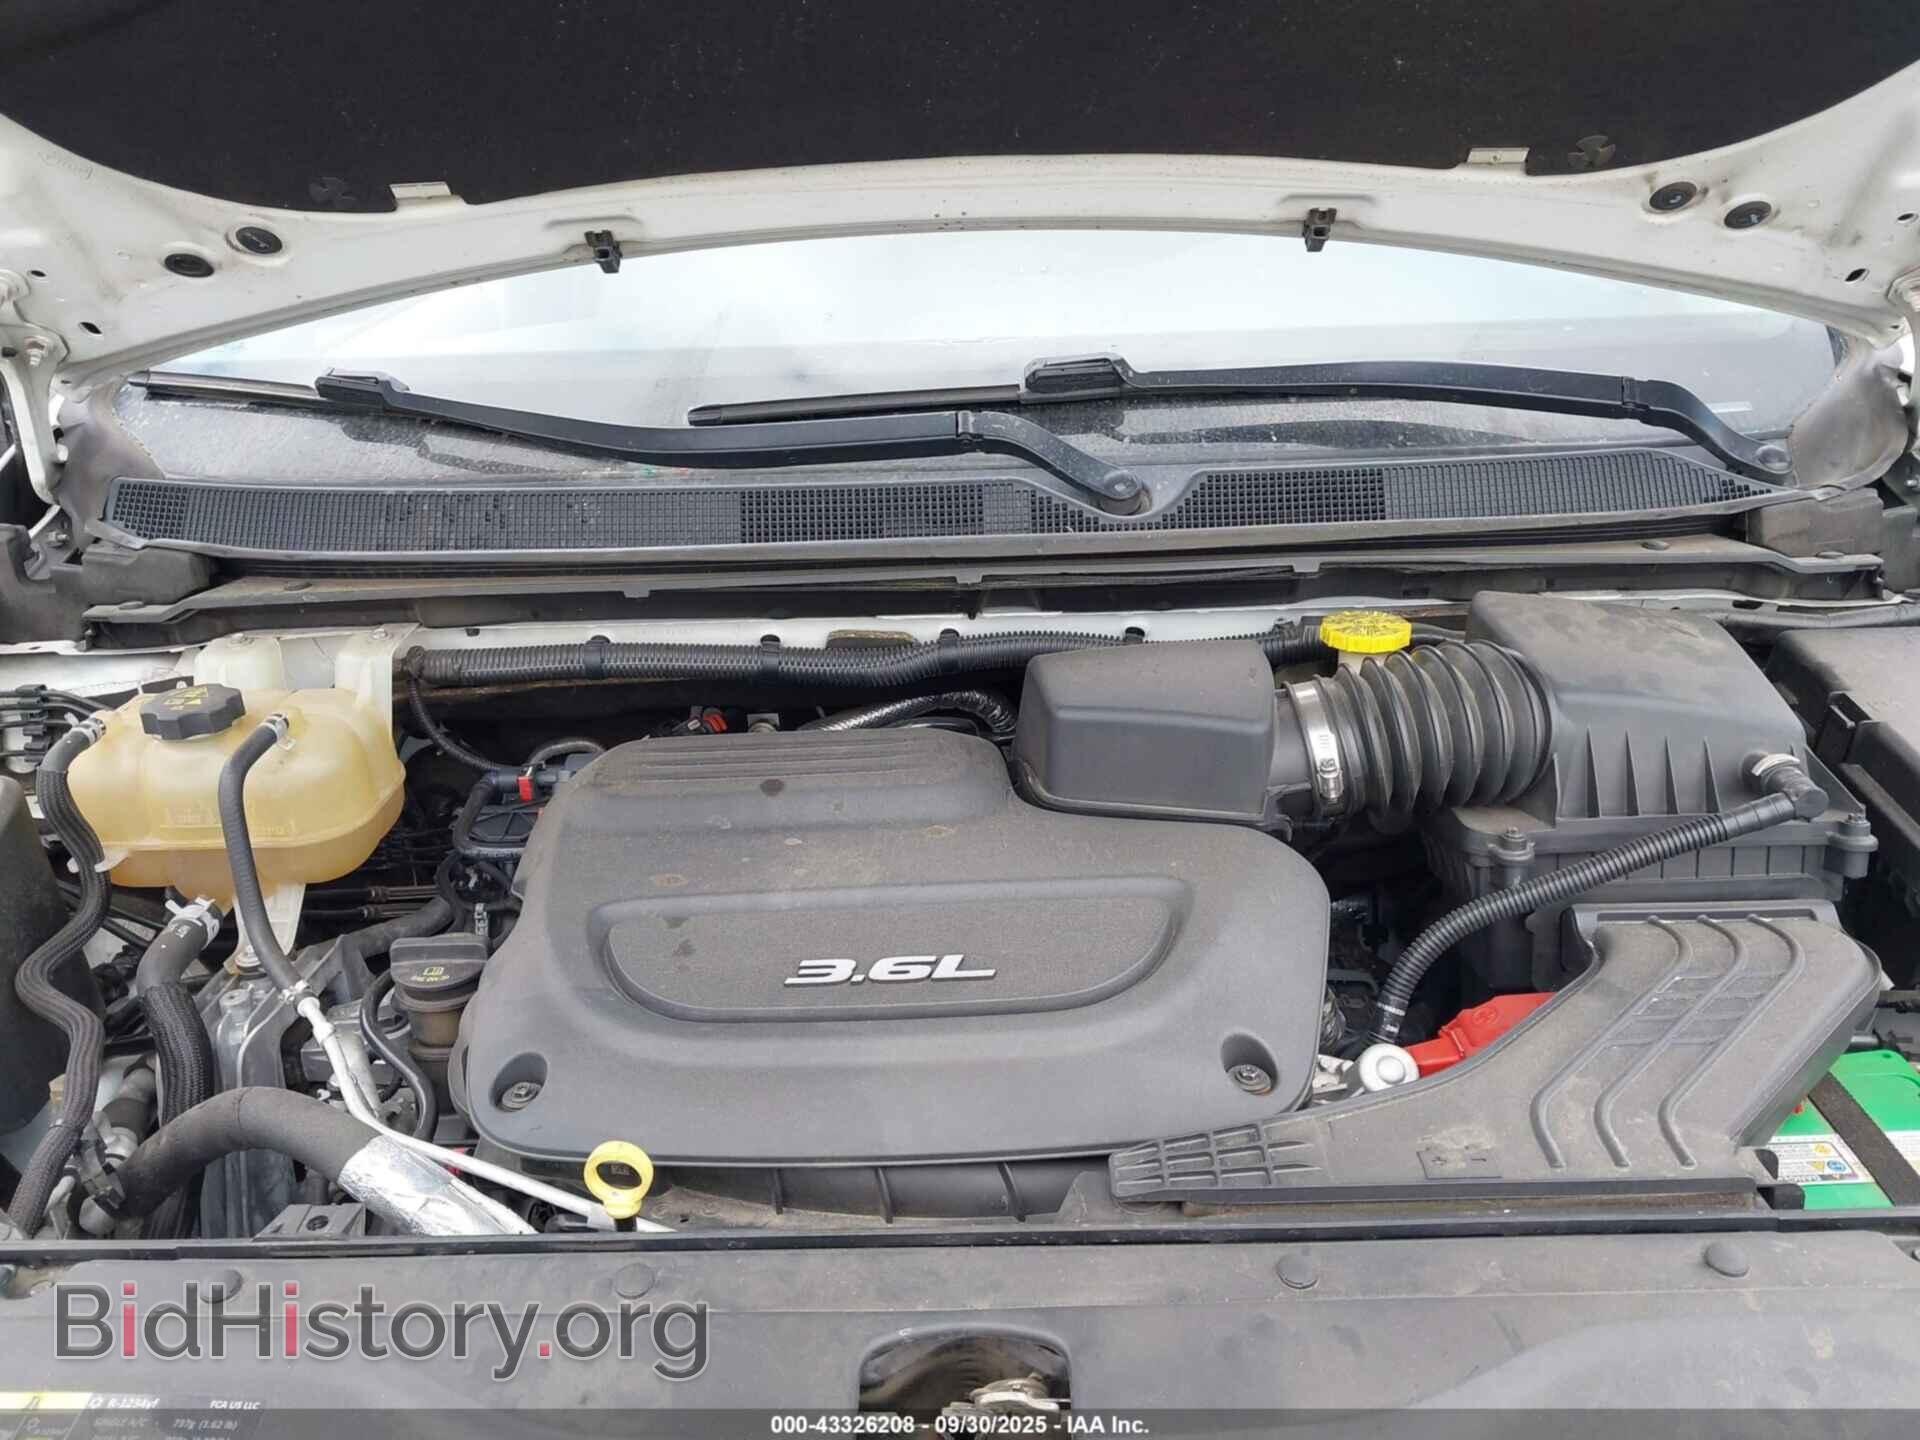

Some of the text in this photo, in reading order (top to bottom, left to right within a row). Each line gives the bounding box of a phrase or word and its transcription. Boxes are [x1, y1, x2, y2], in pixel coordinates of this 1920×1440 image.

[784, 954, 996, 984] 3.6L
[210, 1400, 261, 1410] FCA US LLC
